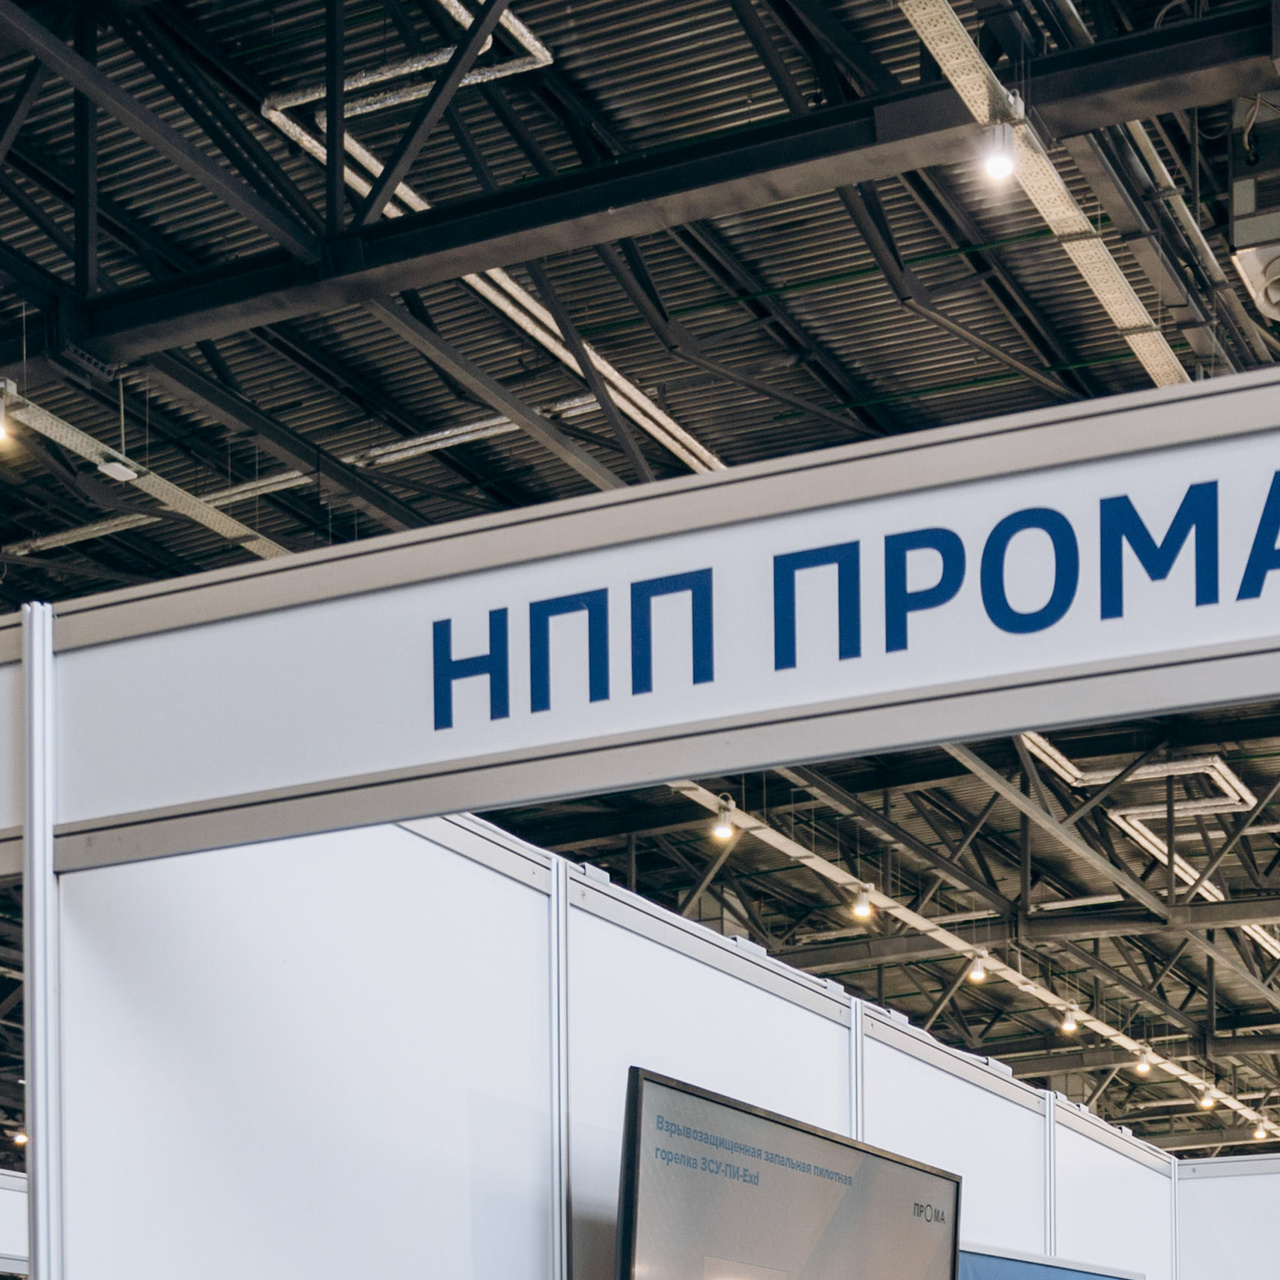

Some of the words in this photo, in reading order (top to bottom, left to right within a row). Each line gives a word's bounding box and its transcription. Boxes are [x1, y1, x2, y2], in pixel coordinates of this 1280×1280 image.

[432, 567, 715, 731] НПП
[655, 1114, 763, 1160] Взрывозащищенная
[654, 1147, 698, 1169] горелка
[913, 1202, 946, 1225] ПРОМА
